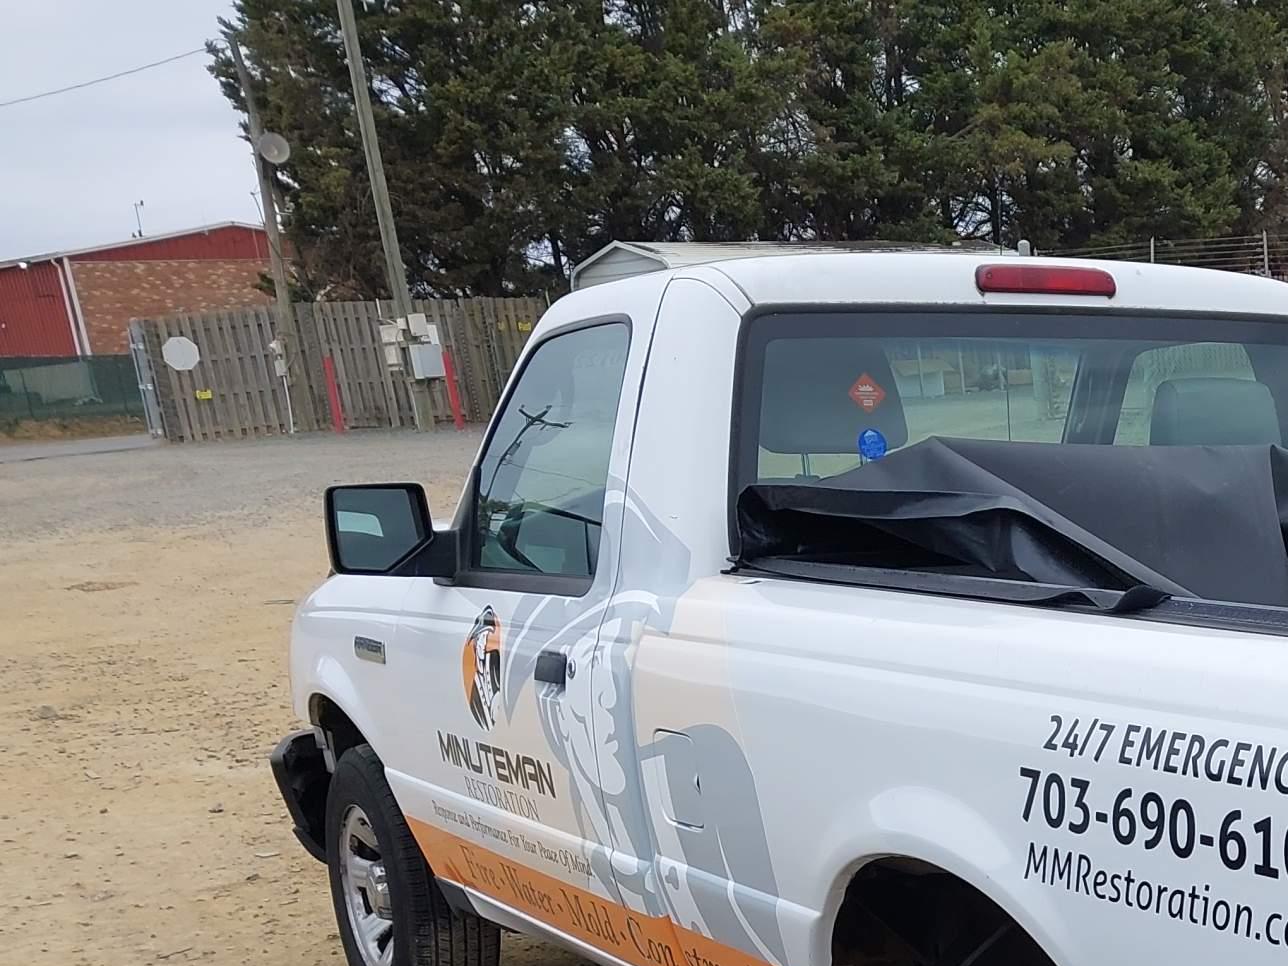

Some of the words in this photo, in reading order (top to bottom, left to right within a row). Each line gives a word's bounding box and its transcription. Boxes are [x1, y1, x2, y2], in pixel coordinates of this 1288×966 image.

[437, 730, 556, 798] MINUTEMAN
[1043, 715, 1116, 763] 24/7
[464, 776, 541, 821] RESTORATION
[460, 844, 501, 890] Fire
[499, 862, 556, 915] Water
[559, 888, 621, 946] Mold
